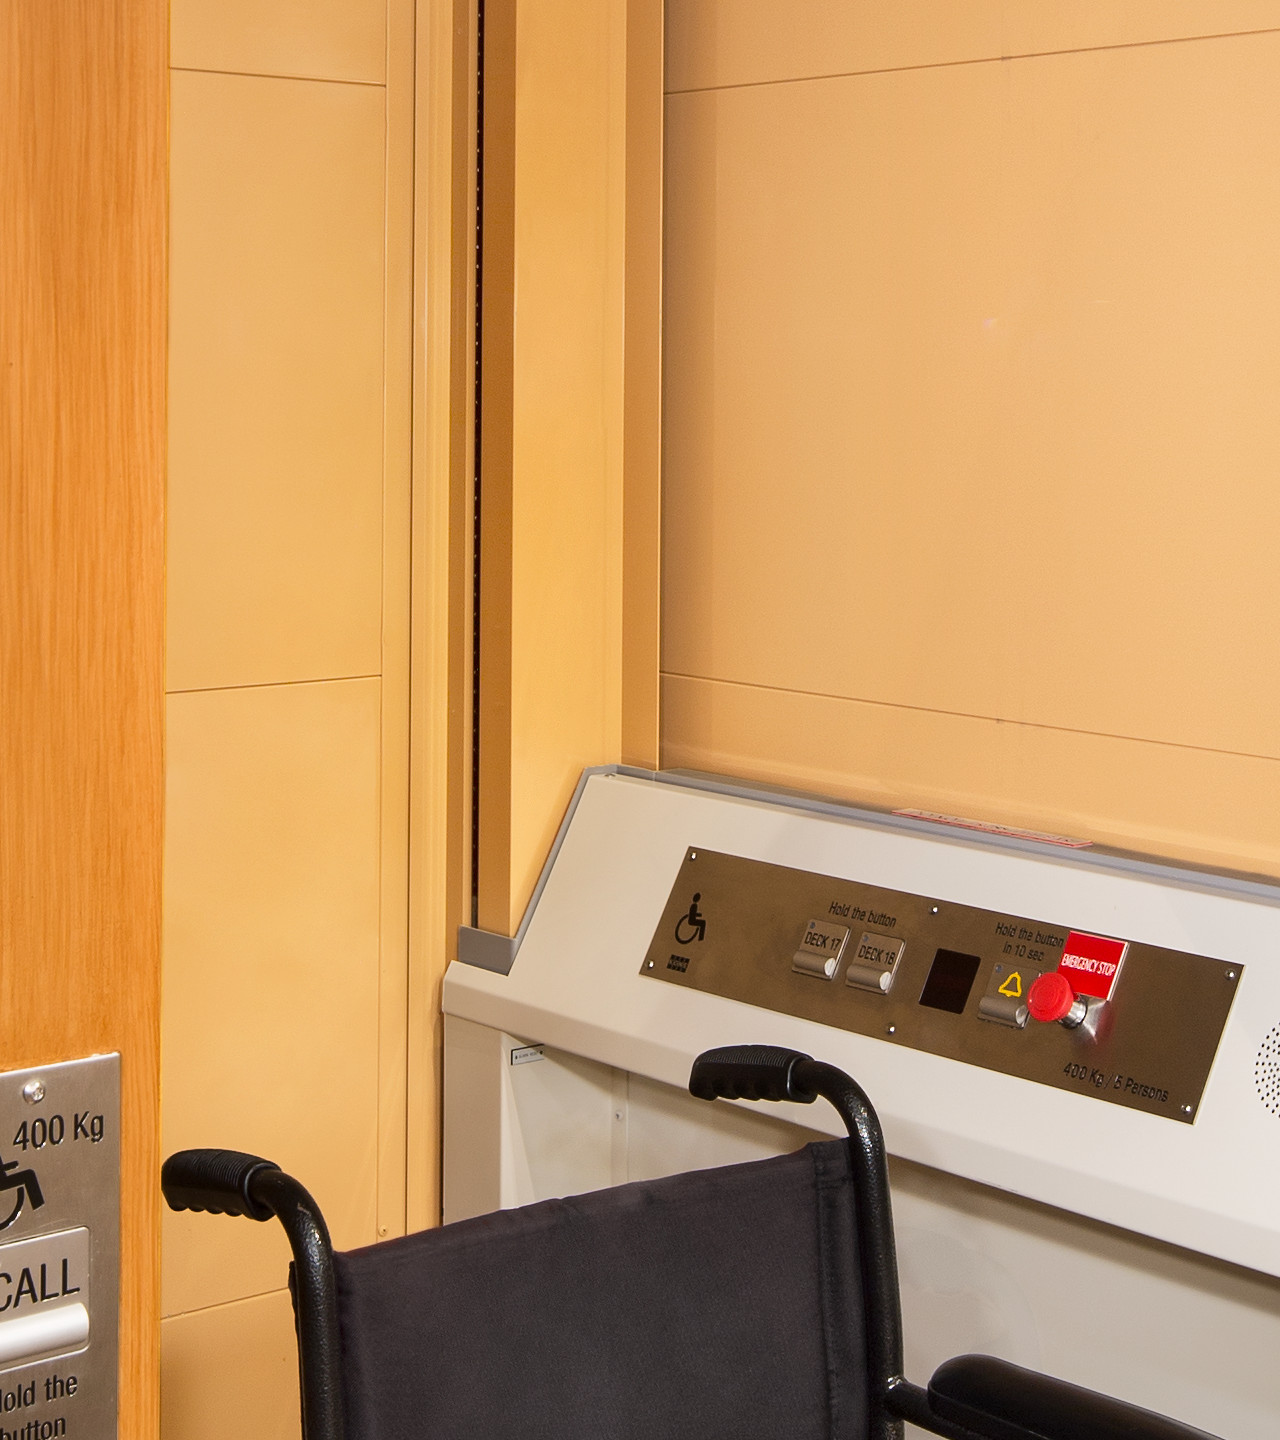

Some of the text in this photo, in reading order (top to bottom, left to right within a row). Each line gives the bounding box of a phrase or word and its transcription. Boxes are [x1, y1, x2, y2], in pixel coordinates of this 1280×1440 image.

[828, 901, 897, 929] Hold the button
[804, 931, 841, 951] DECK 17
[995, 922, 1064, 948] Hold the button
[858, 945, 896, 965] DECK 18
[1014, 943, 1027, 958] 10
[1027, 948, 1045, 962] sec
[1061, 953, 1117, 976] EMERGENCY STOP
[1063, 1062, 1088, 1080] 400
[1088, 1068, 1104, 1088] Kg
[1113, 1075, 1123, 1089] 5
[1124, 1077, 1169, 1102] Persons
[13, 1111, 105, 1152] 400 Kg
[44, 1375, 78, 1402] the
